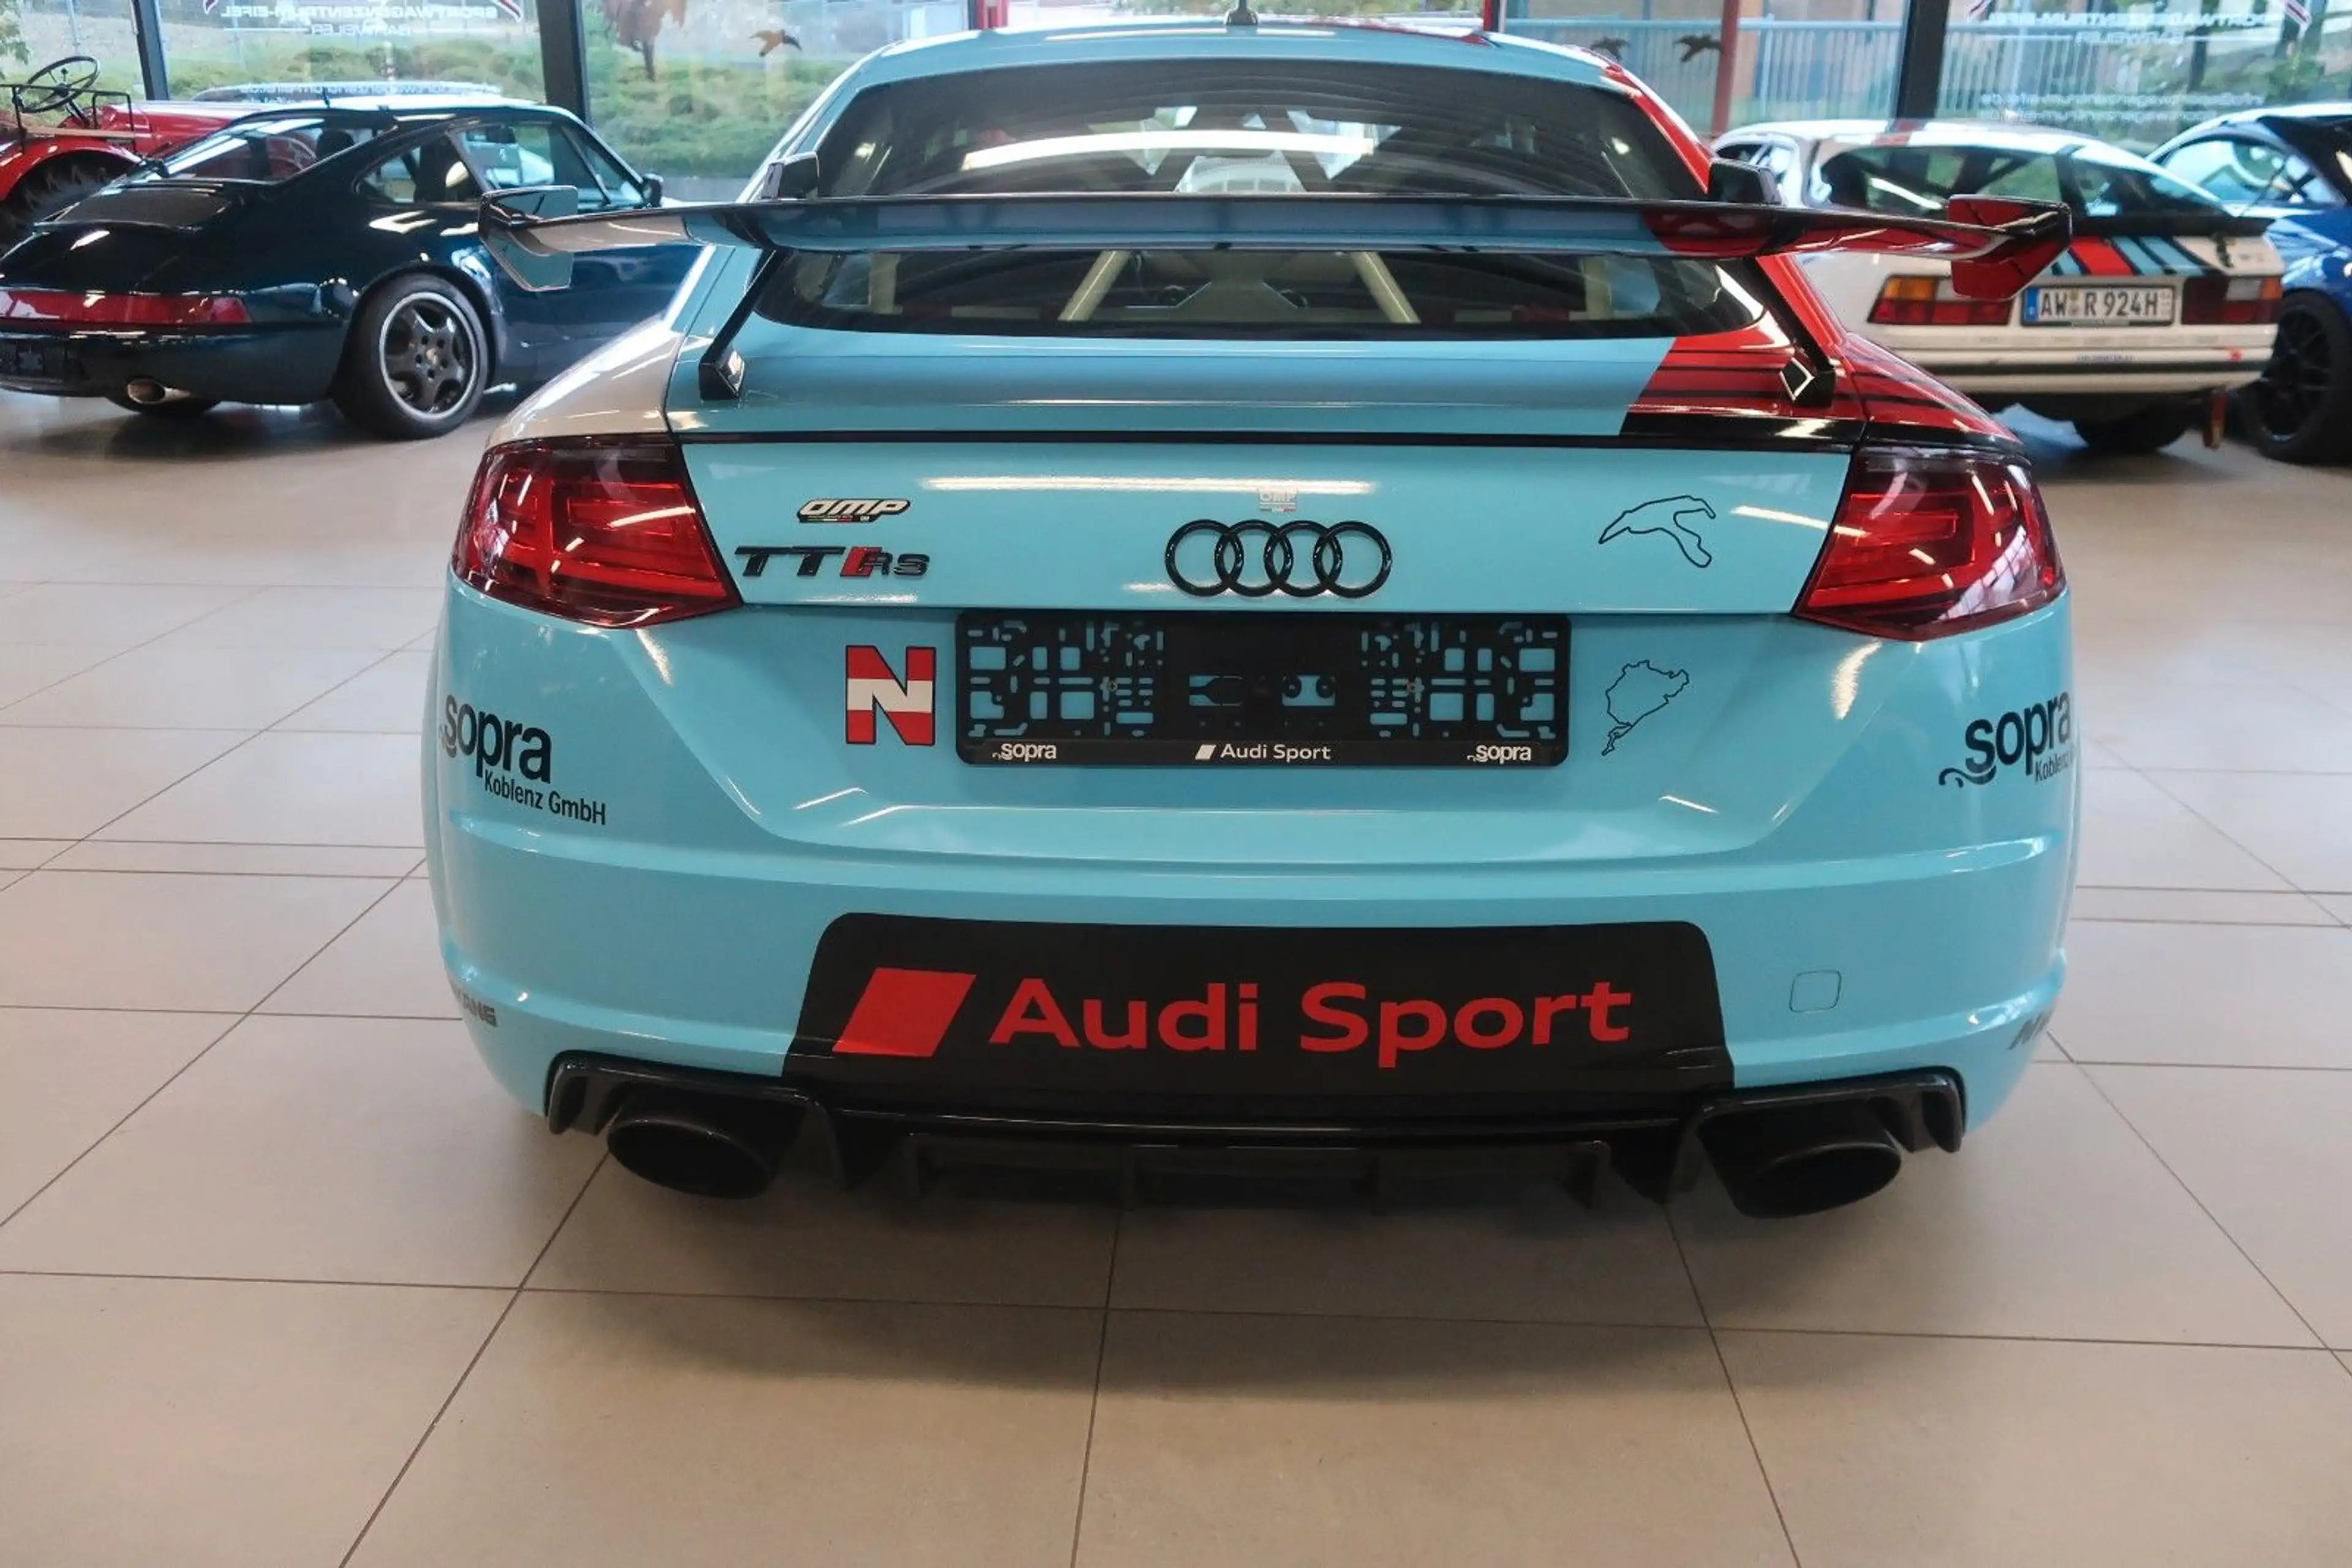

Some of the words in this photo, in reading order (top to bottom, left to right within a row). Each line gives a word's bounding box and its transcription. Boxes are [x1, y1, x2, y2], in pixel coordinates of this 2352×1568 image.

[2041, 291, 2067, 315] AW
[2084, 292, 2097, 315] R
[2105, 292, 2158, 316] 924H
[846, 645, 936, 745] N
[444, 694, 551, 784] sopra
[1000, 743, 1057, 763] sopra
[1220, 744, 1267, 759] Audi
[1273, 744, 1332, 763] Sport
[1476, 744, 1531, 764] sopra
[1964, 691, 2070, 776] sopra
[484, 769, 544, 810] Koblenz
[548, 790, 606, 826] GmbH
[989, 978, 1259, 1051] Audi
[1299, 981, 1632, 1068] Sport
